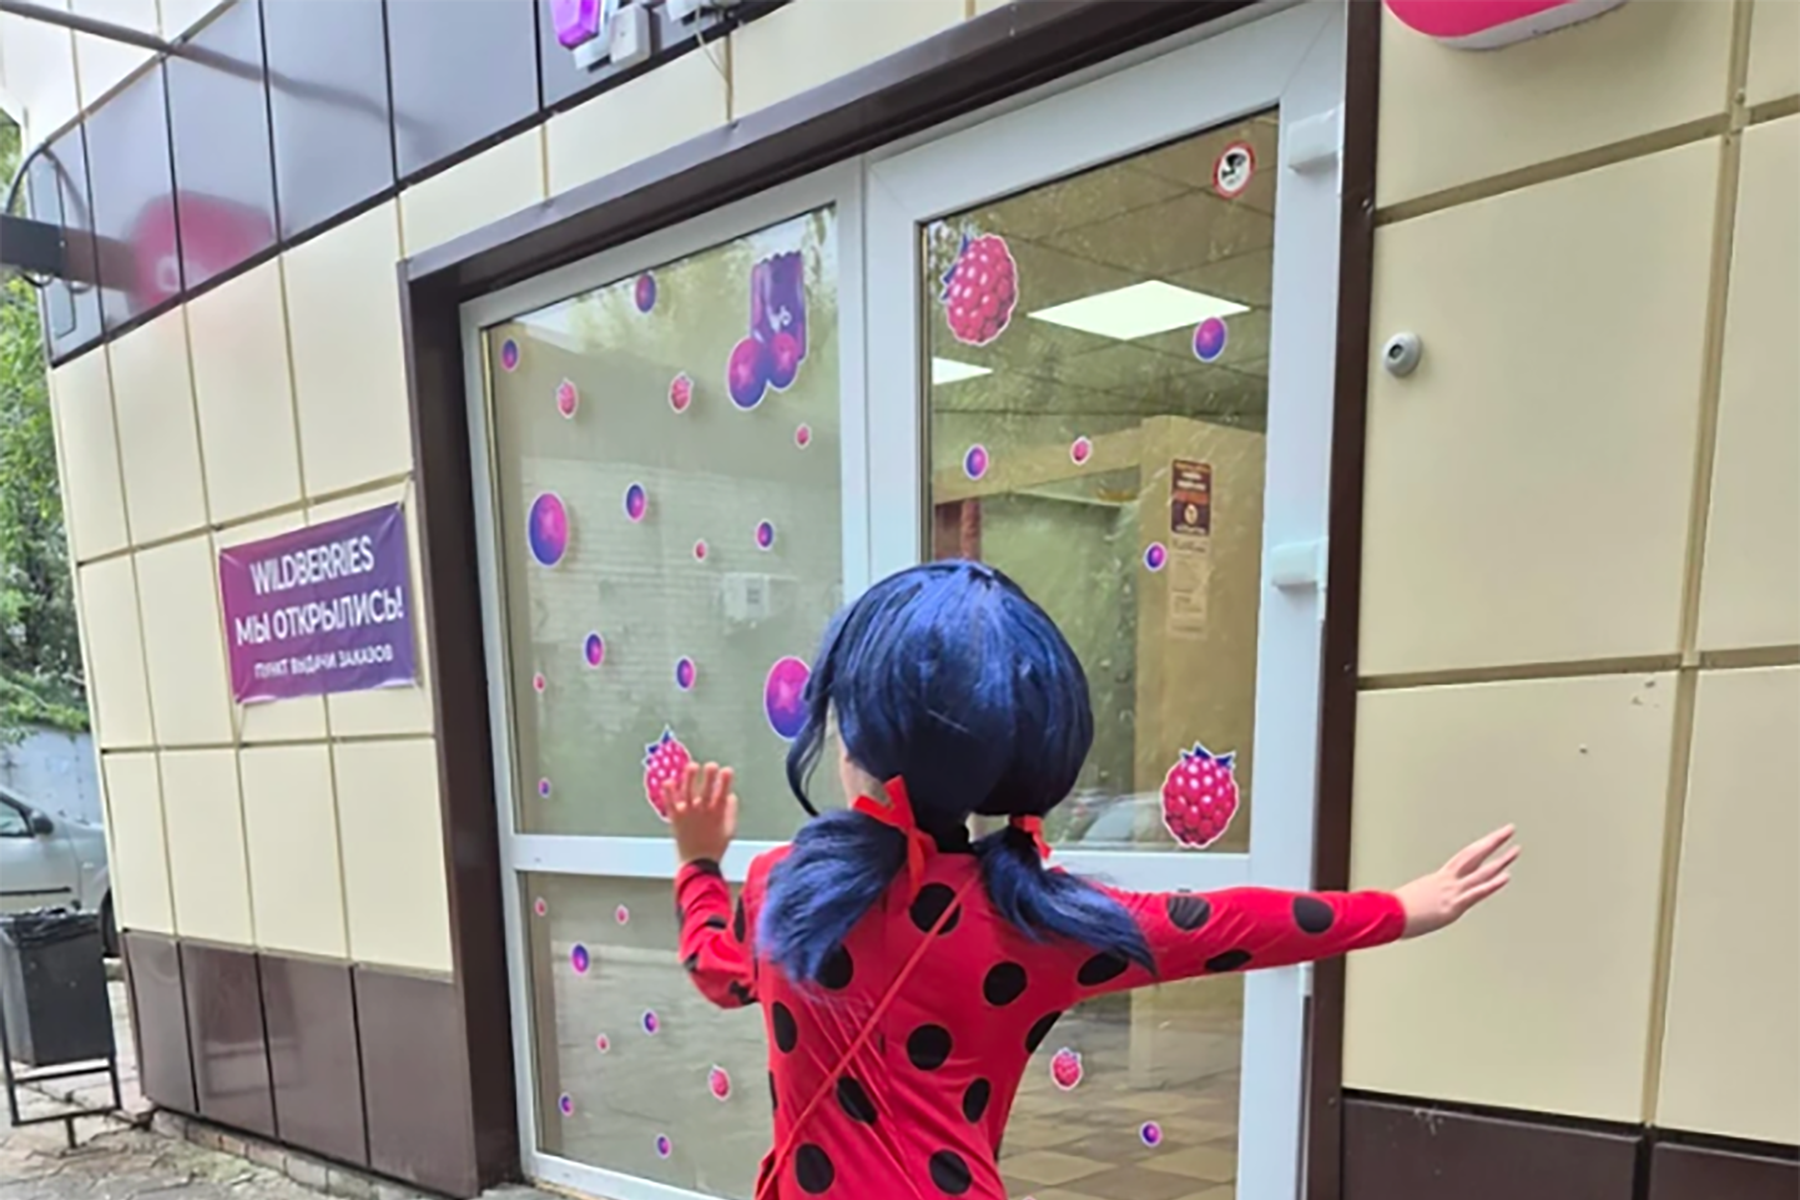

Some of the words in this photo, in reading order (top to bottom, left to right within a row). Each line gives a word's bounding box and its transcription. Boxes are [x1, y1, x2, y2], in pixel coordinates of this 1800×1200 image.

[250, 535, 375, 595] WILDBERRIES
[235, 611, 271, 646] МЫ
[272, 586, 404, 639] ОТКРЫЛИСЬ!
[254, 658, 289, 678] ПУНКТ
[291, 651, 337, 674] ВЫДАЧИ
